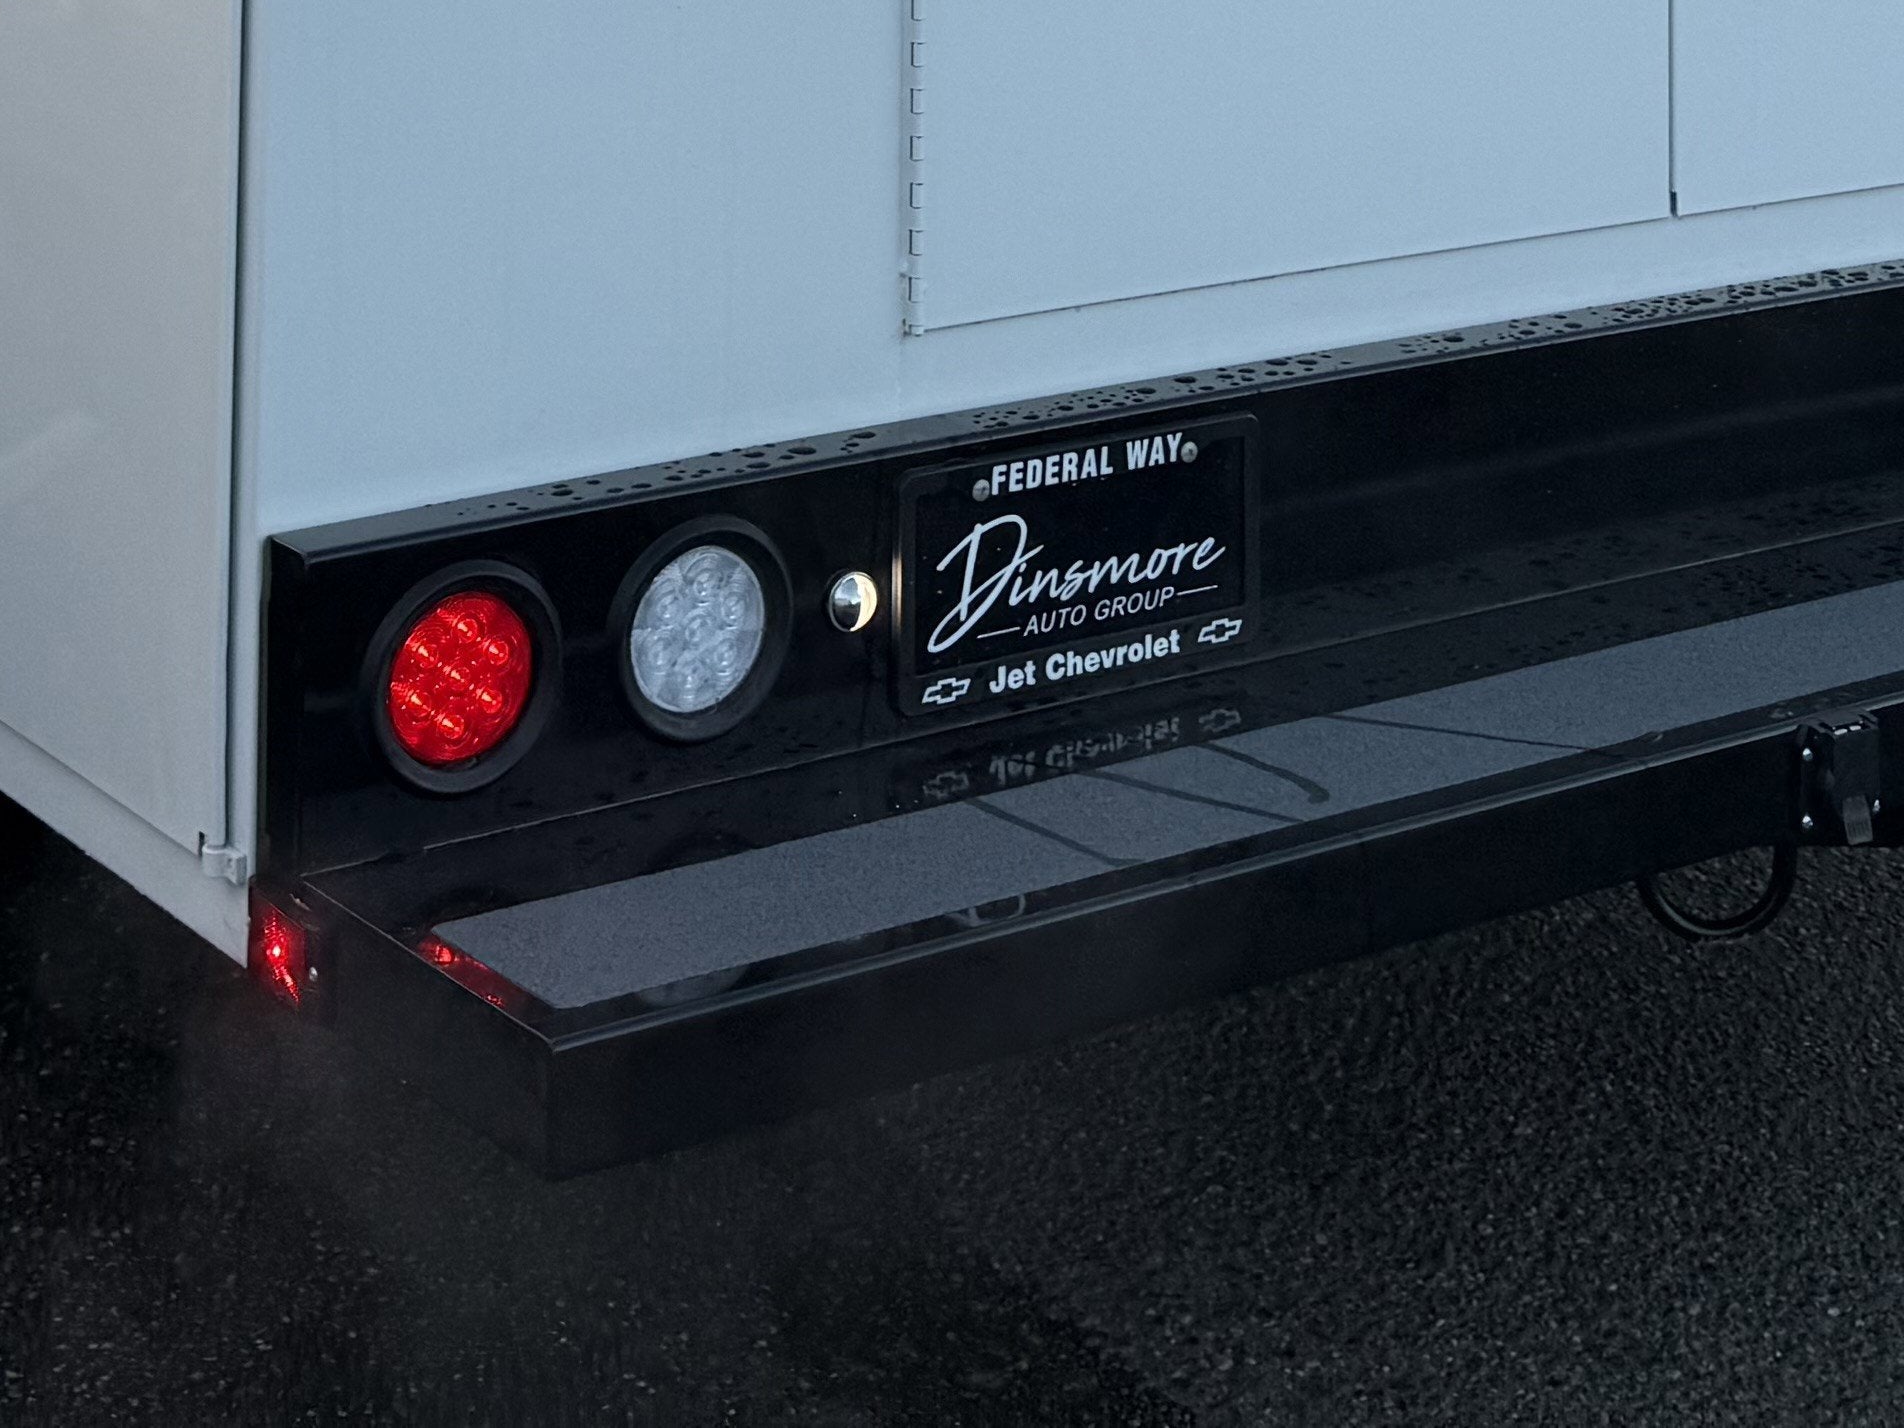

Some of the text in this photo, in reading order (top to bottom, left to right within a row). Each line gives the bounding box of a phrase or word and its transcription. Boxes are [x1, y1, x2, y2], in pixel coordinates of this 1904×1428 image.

[991, 432, 1183, 495] FEDERAL WAY
[927, 514, 1226, 653] Dinsmore
[1023, 586, 1175, 637] AUTO GROUP
[989, 629, 1181, 694] Jet Chevrolet
